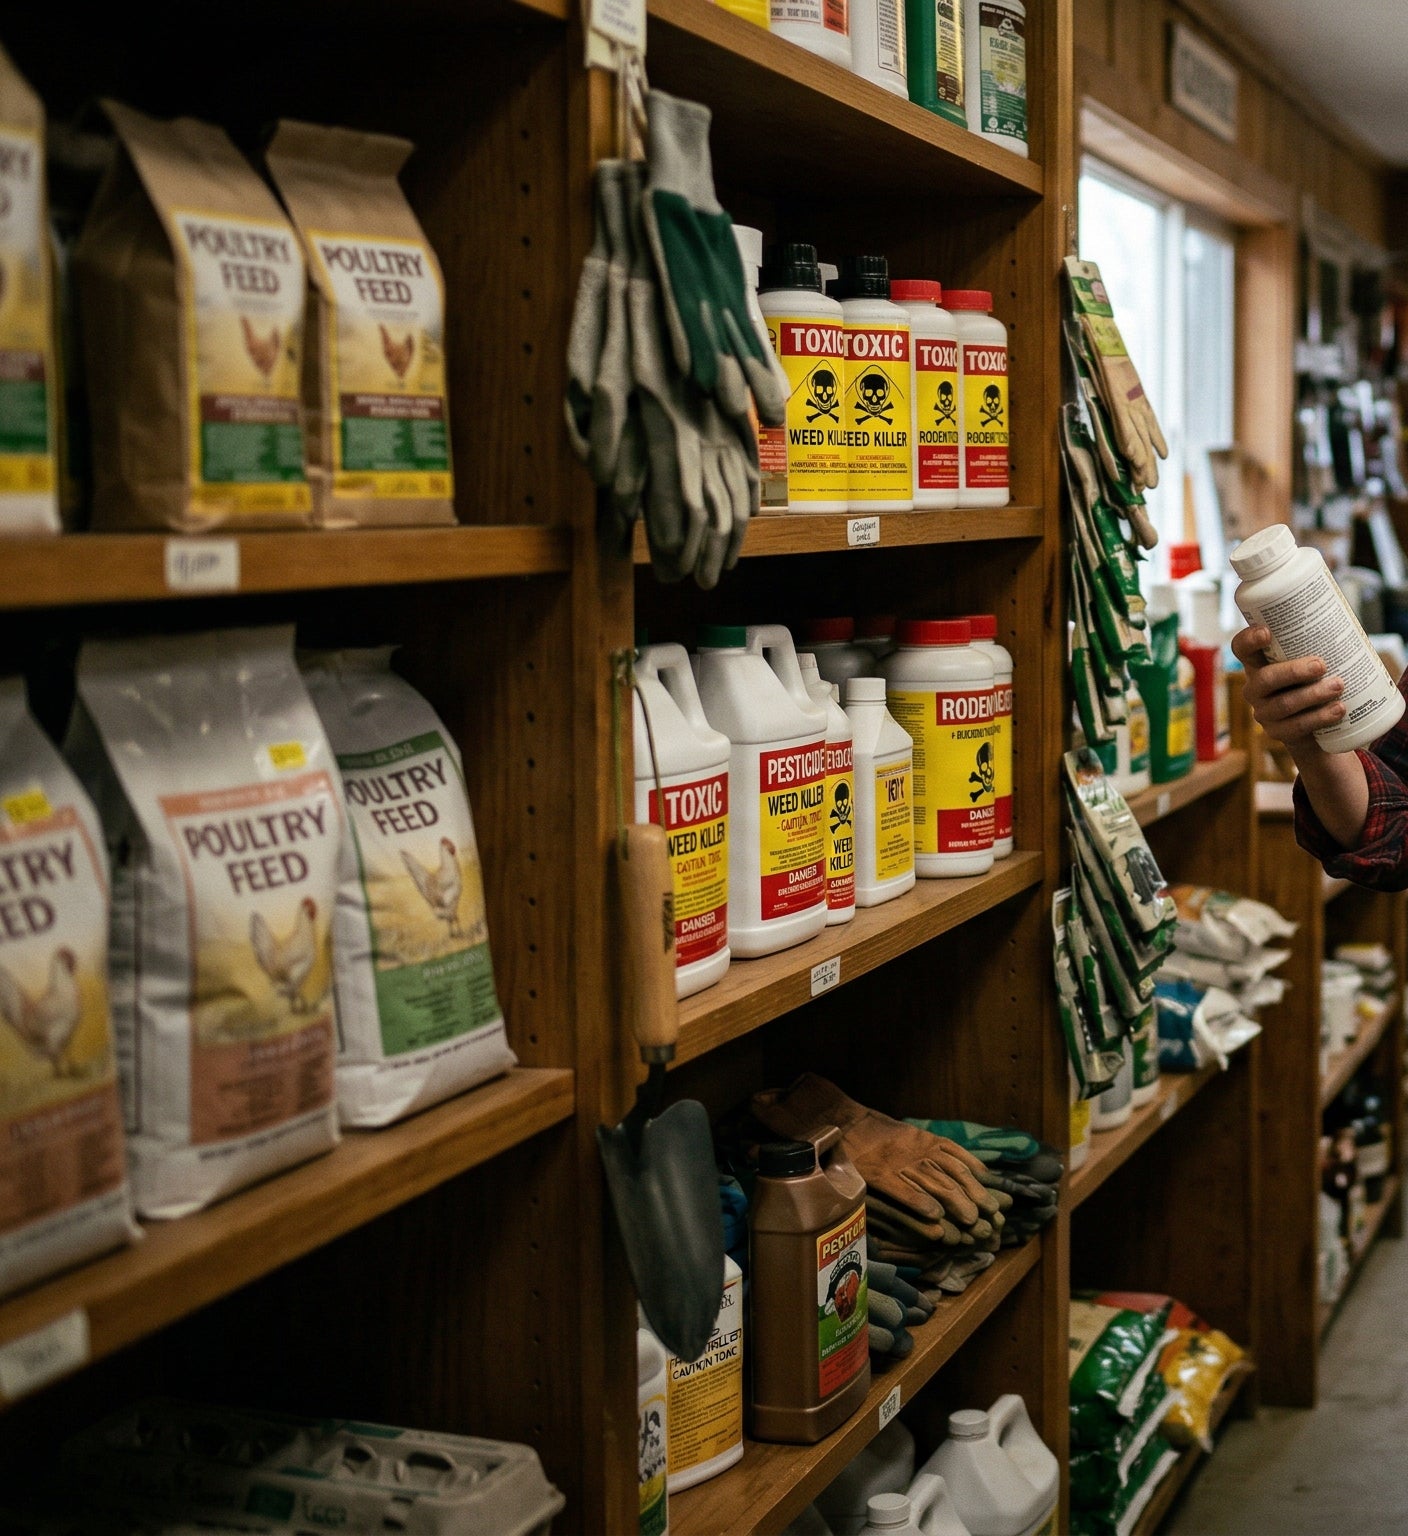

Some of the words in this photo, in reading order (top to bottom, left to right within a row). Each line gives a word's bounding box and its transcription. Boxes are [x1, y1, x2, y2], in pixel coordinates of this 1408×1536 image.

[184, 222, 292, 265] POULTRY
[320, 243, 425, 279] POULTRY
[219, 262, 281, 295] FEED
[354, 277, 413, 304] FEED
[791, 327, 843, 353] TOXIC
[843, 333, 903, 358] TOXIC
[919, 345, 957, 367] TOXIC
[966, 351, 1007, 372] TOXIC
[789, 429, 824, 446] WEED
[846, 431, 870, 447] EED
[874, 431, 907, 447] KILLER
[768, 748, 825, 785] PESTICIDE
[371, 799, 439, 836] FEED
[665, 780, 722, 825] TOXIC
[768, 792, 798, 817] WEED
[184, 803, 325, 860] POULTRY
[0, 837, 75, 893] TRY
[226, 850, 309, 895] FEED
